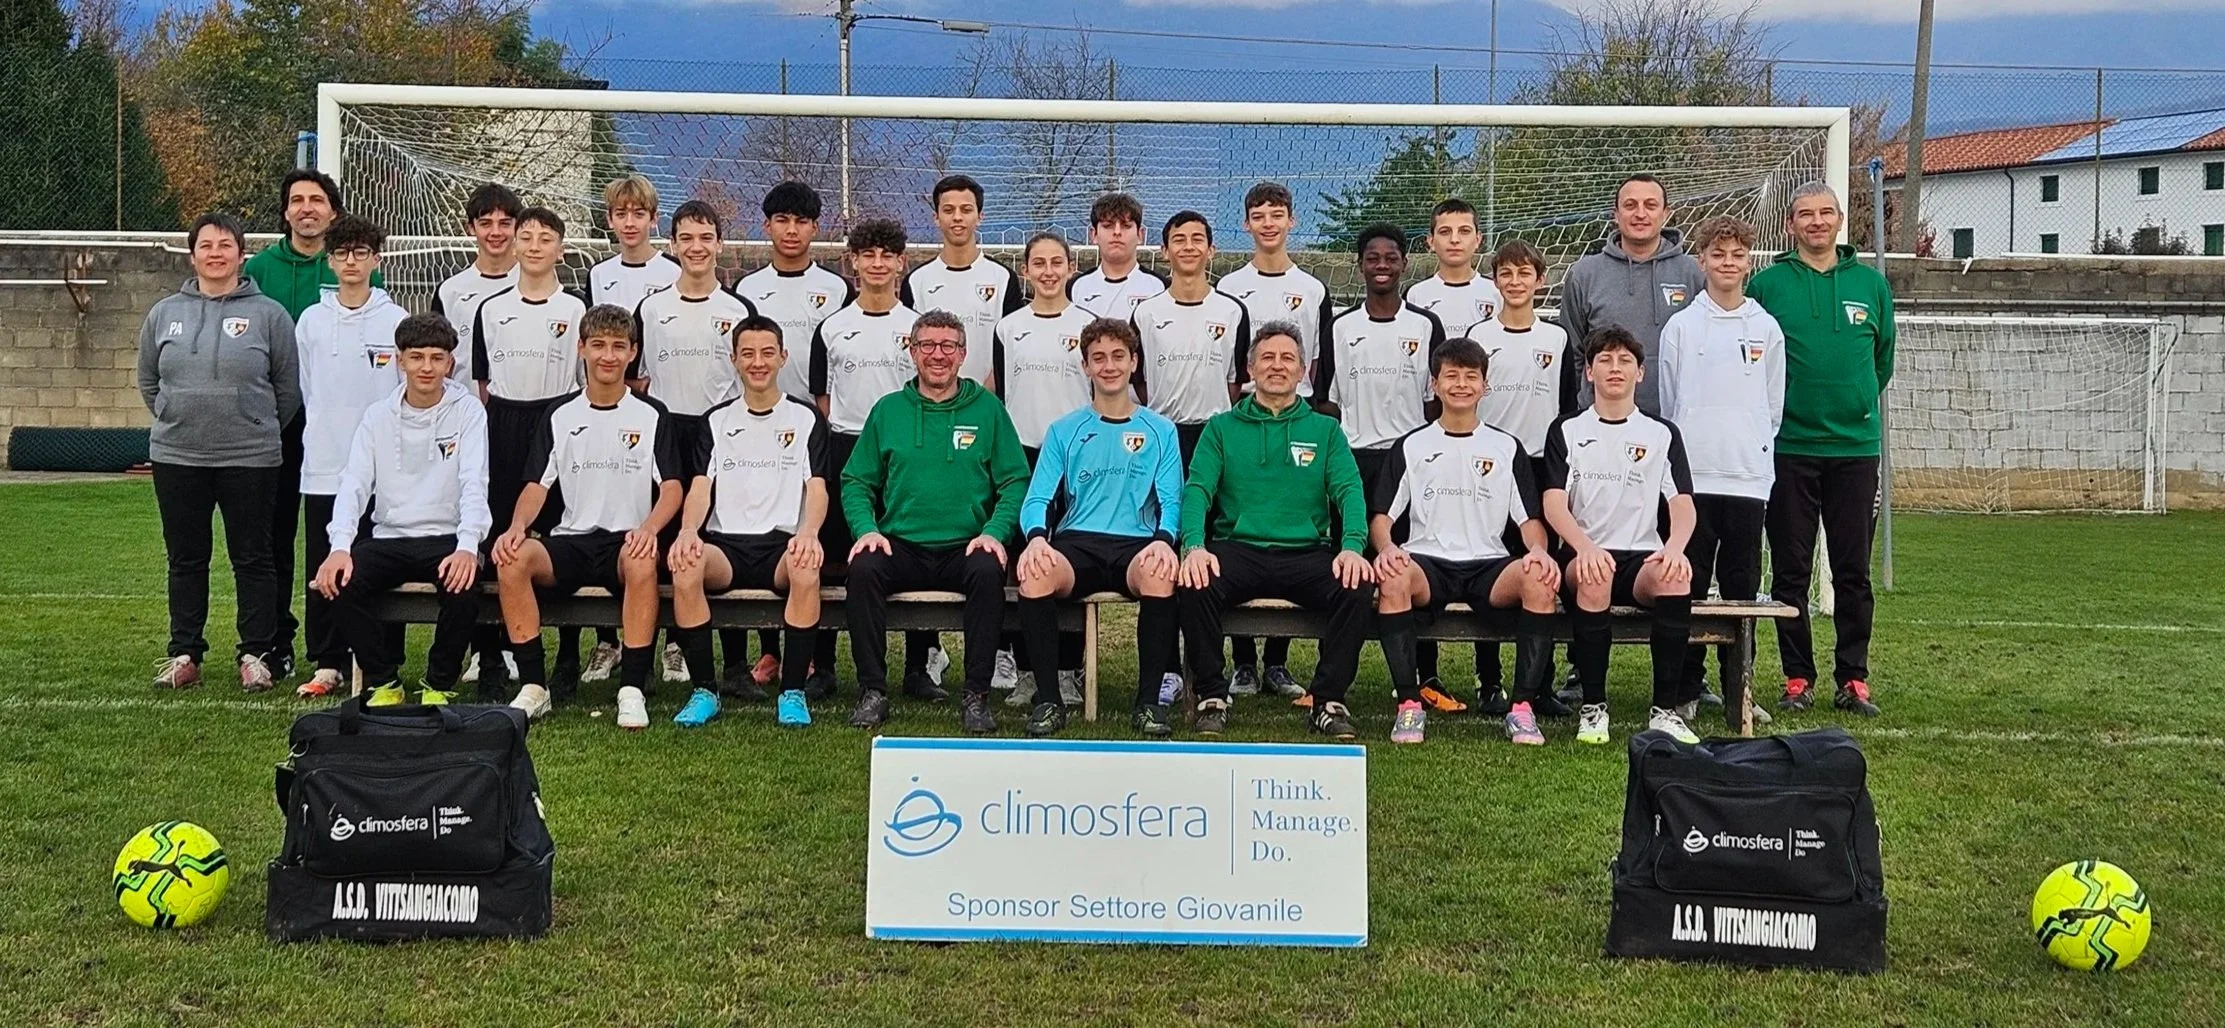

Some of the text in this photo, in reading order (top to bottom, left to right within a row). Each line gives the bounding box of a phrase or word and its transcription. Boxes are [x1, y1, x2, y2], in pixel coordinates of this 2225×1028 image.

[168, 321, 183, 336] PA
[1251, 778, 1332, 801] Think.
[358, 815, 428, 834] climosfera
[980, 789, 1208, 838] climosfera
[1251, 810, 1358, 837] Manage.
[1251, 841, 1291, 862] Do.
[1712, 831, 1783, 850] climosfera
[332, 882, 479, 923] A.S.D. VITTSANGIACOMO
[948, 893, 1303, 921] Sponsor Settore Giovanile
[1672, 904, 1817, 951] A.S.D. VITTSANGIACOMO
